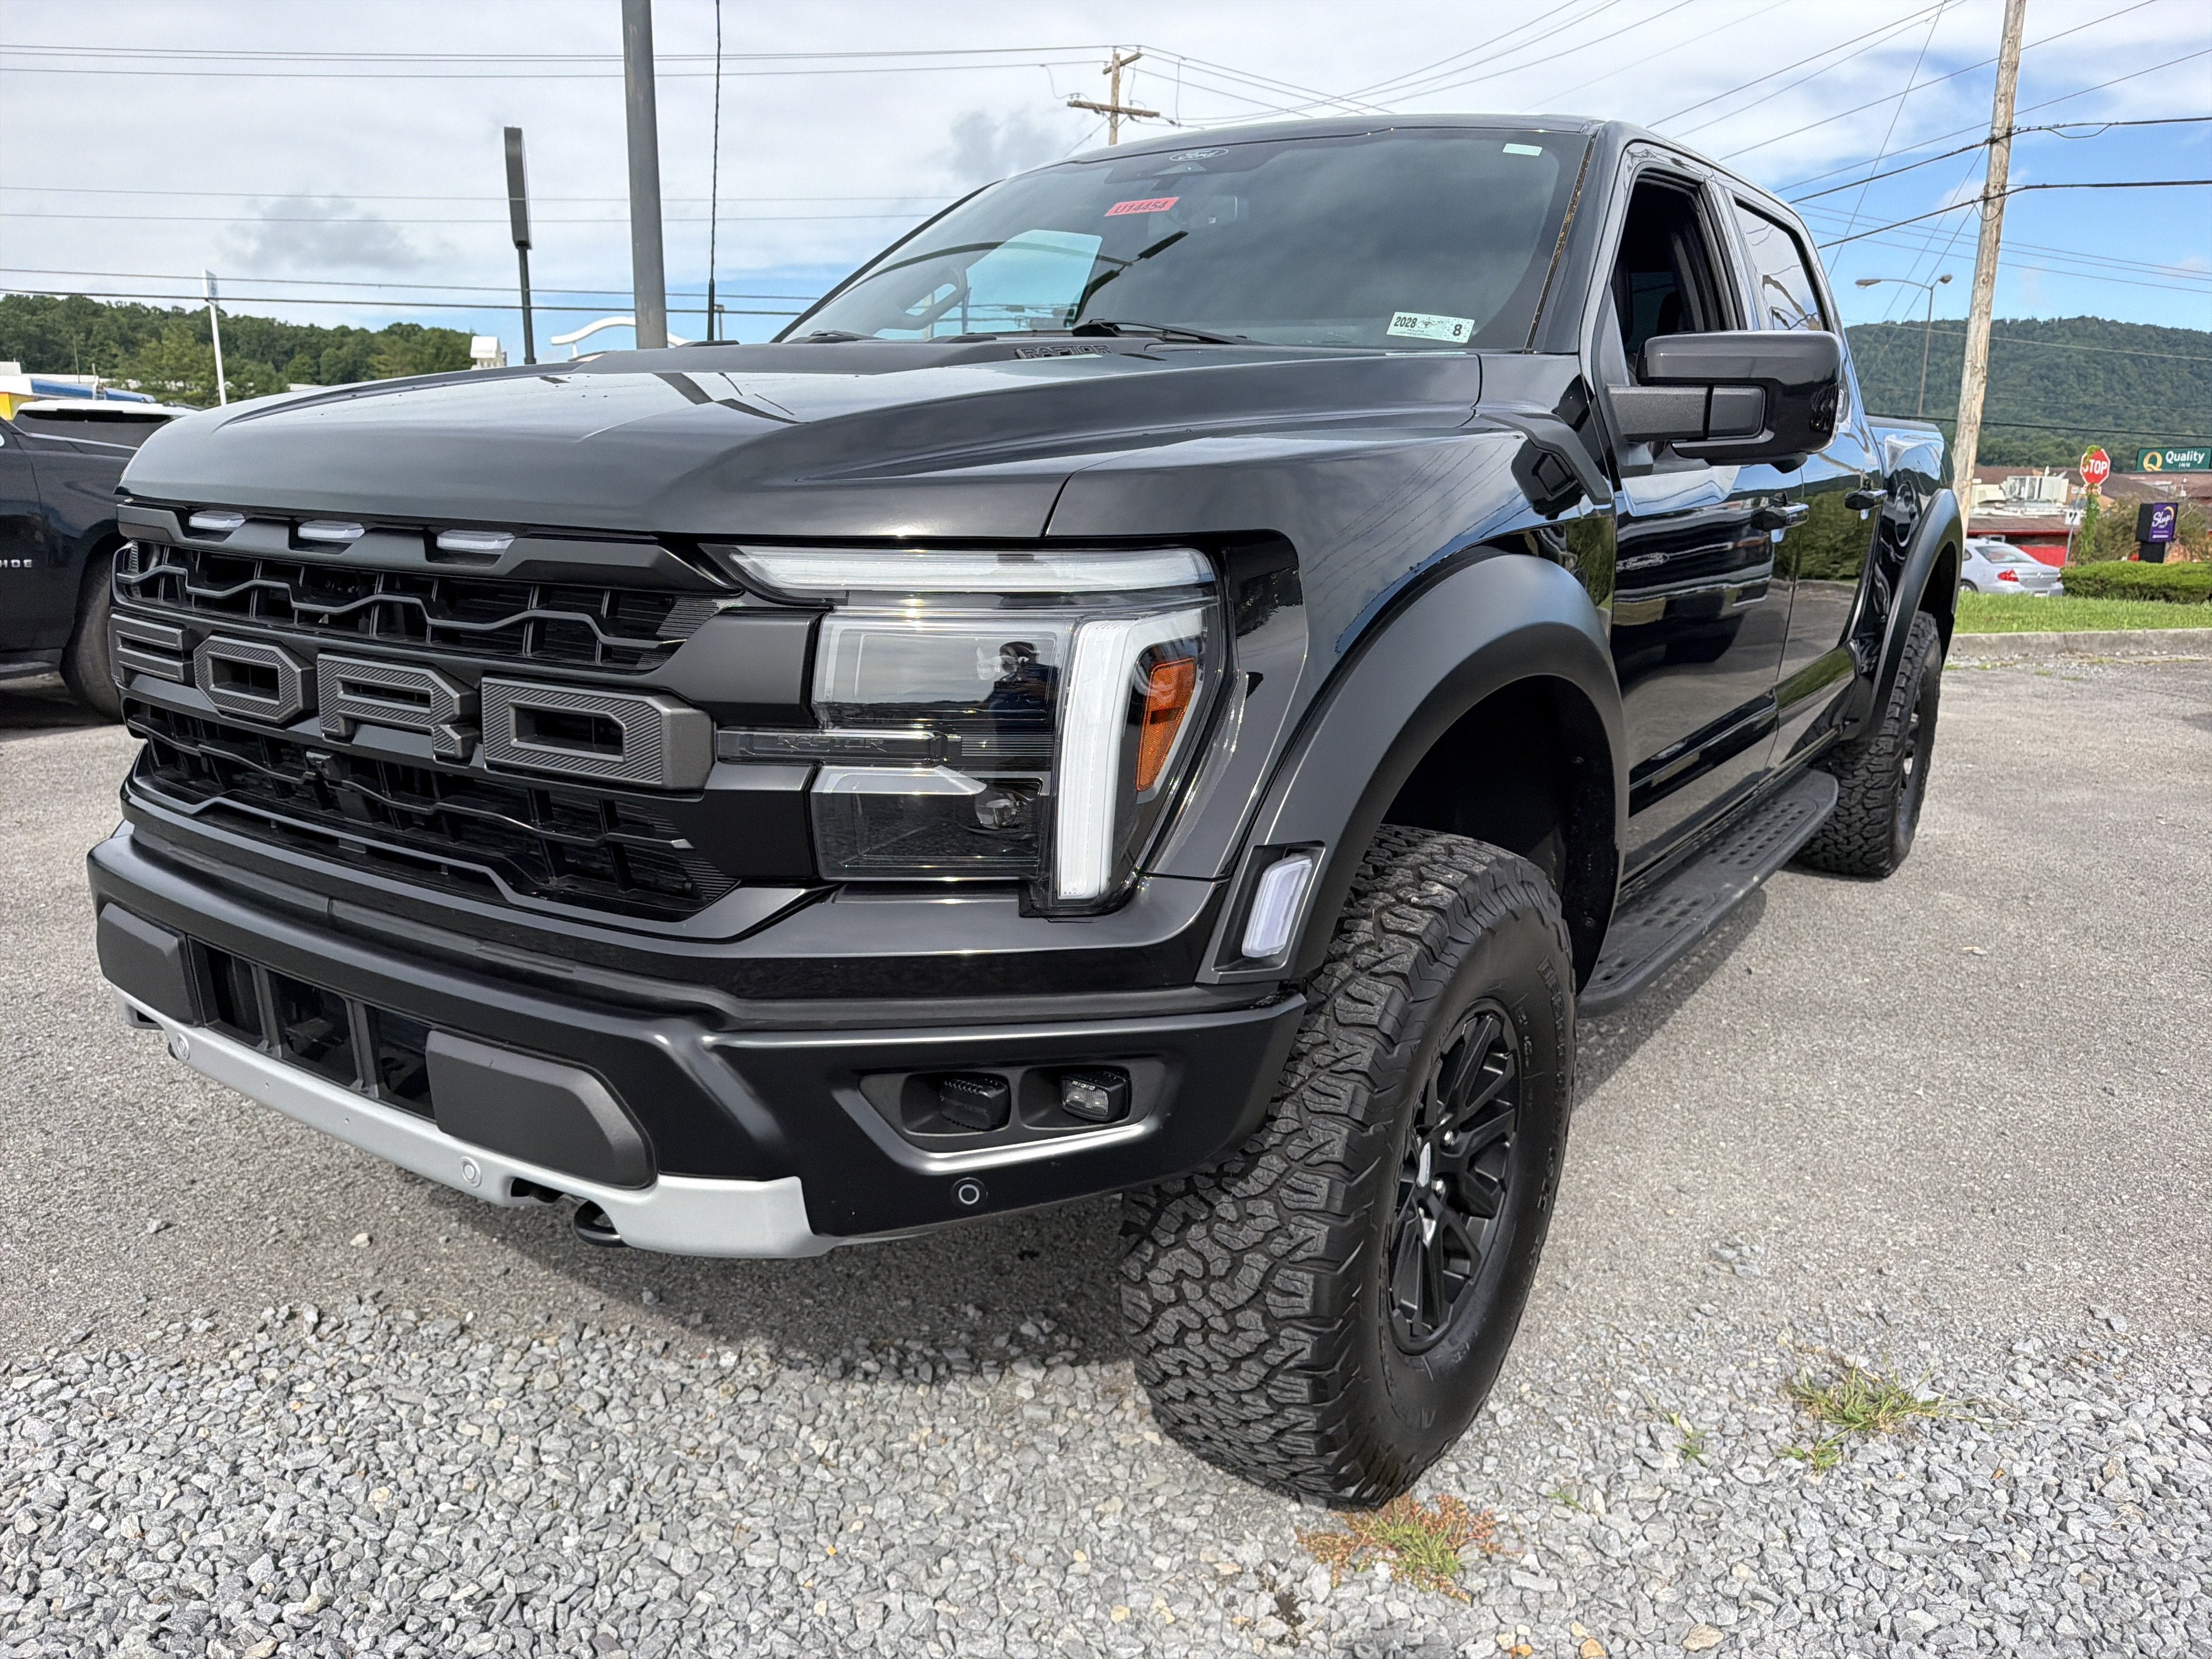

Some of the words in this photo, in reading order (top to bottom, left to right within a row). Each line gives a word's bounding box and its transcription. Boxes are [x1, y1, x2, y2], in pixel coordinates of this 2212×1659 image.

[1114, 201, 1169, 214] U14454
[1394, 316, 1418, 328] 2028
[1452, 324, 1463, 336] 8
[1015, 345, 1114, 359] RAPTOR
[2165, 450, 2205, 464] Quality
[108, 612, 711, 790] FORD
[776, 735, 888, 753] RAPTOR
[1072, 1080, 1096, 1091] RIGID
